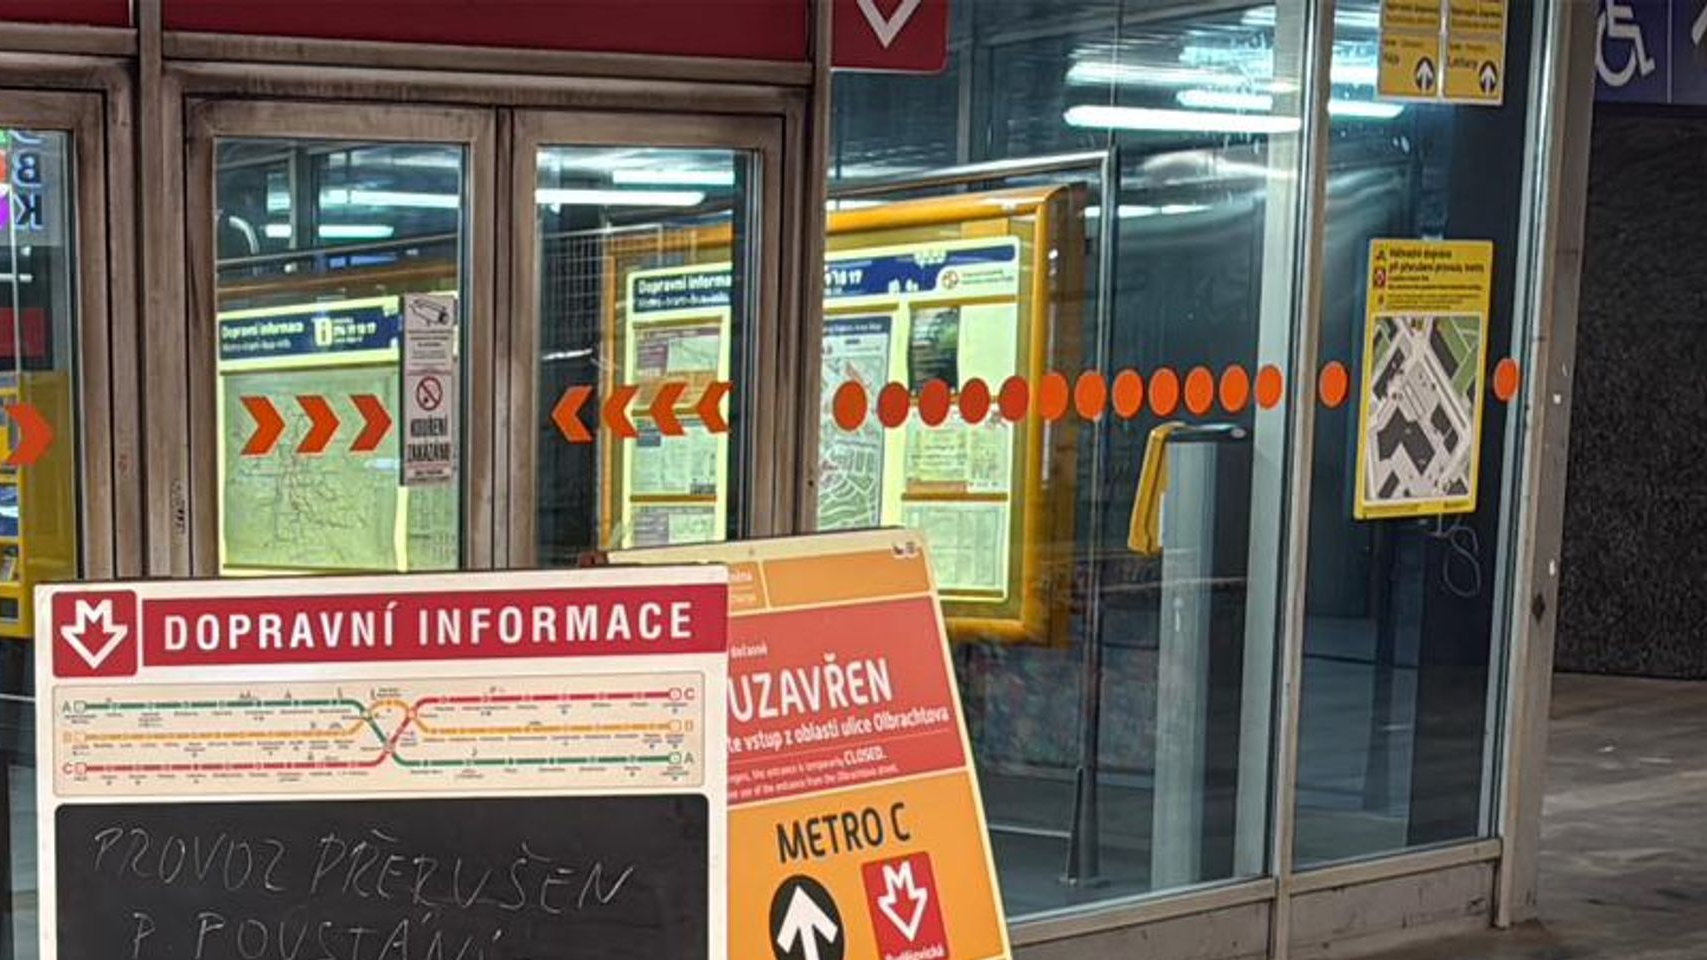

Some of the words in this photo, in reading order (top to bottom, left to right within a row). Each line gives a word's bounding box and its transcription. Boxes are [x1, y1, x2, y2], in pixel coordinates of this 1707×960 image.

[164, 601, 398, 651] DOPRAVNÍ
[418, 602, 693, 646] INFORMACE
[727, 652, 892, 722] UZAVŘEN
[94, 827, 287, 892] PROVOZ
[776, 806, 884, 864] METRO
[890, 802, 912, 842] C
